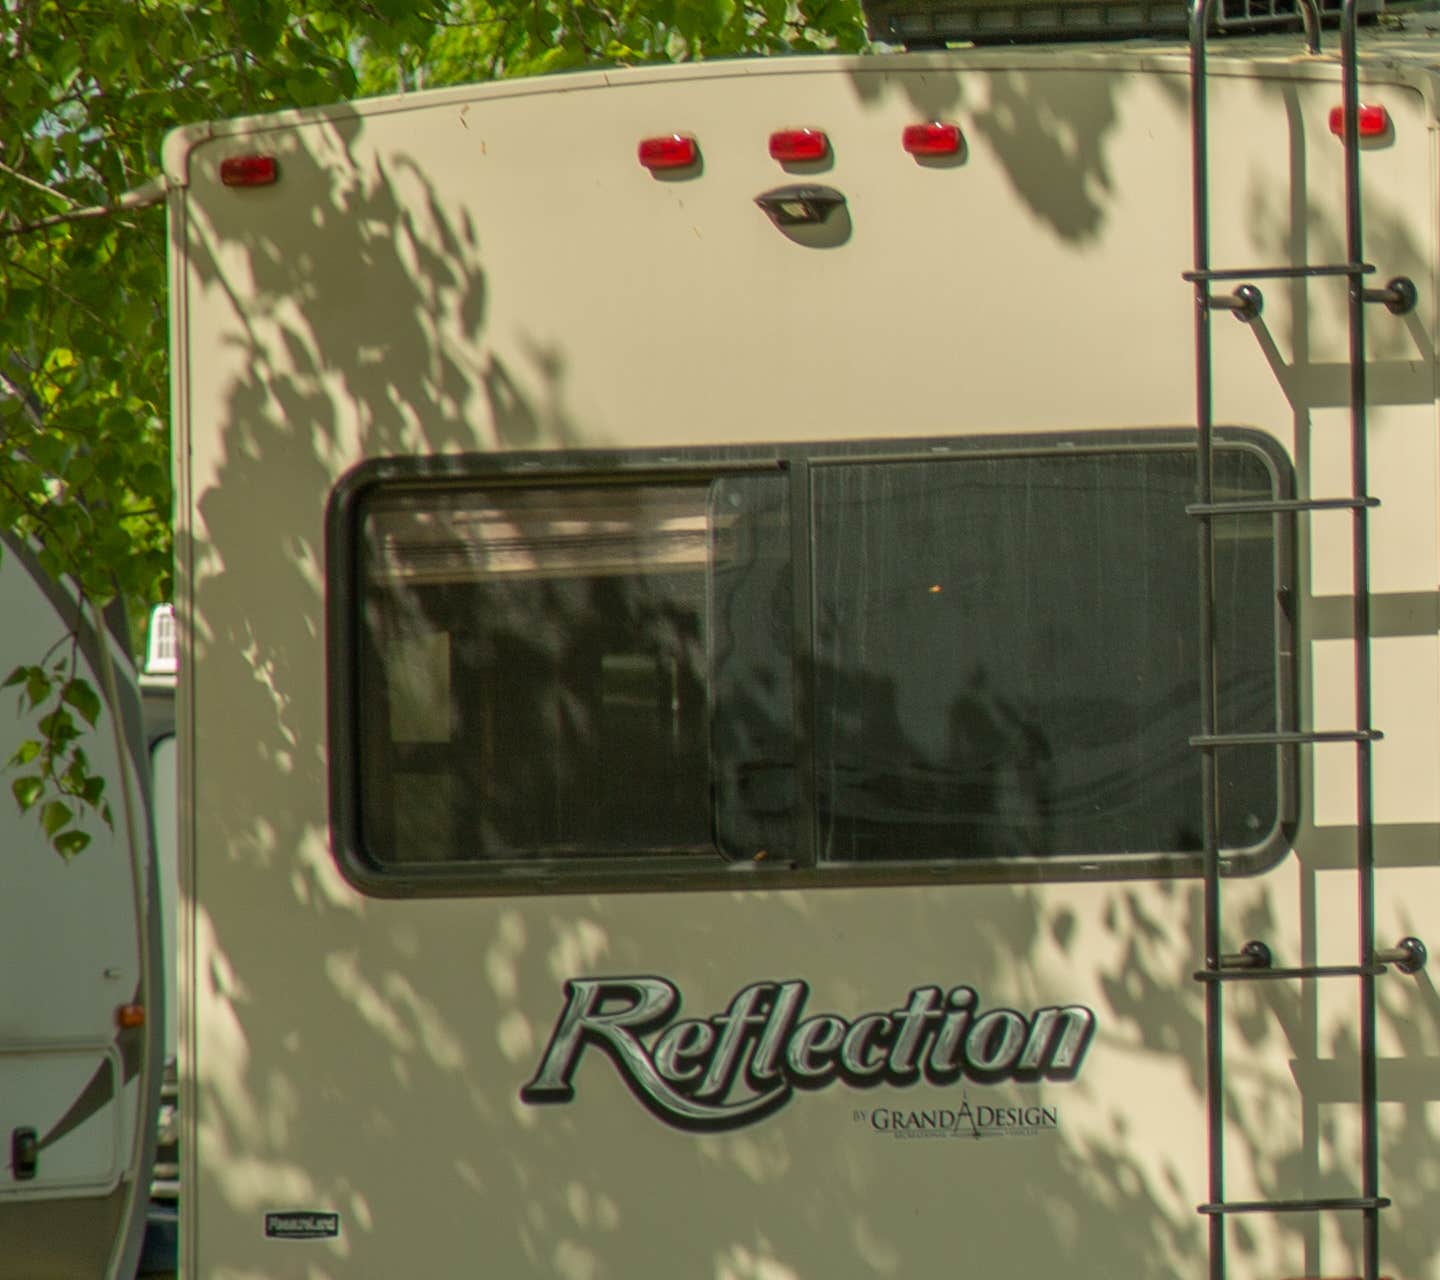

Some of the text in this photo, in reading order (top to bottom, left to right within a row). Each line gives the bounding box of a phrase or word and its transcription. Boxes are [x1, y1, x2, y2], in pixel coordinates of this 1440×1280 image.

[520, 974, 1097, 1133] Reflection
[871, 1108, 955, 1131] GRAND
[976, 1105, 1058, 1128] DESIGN
